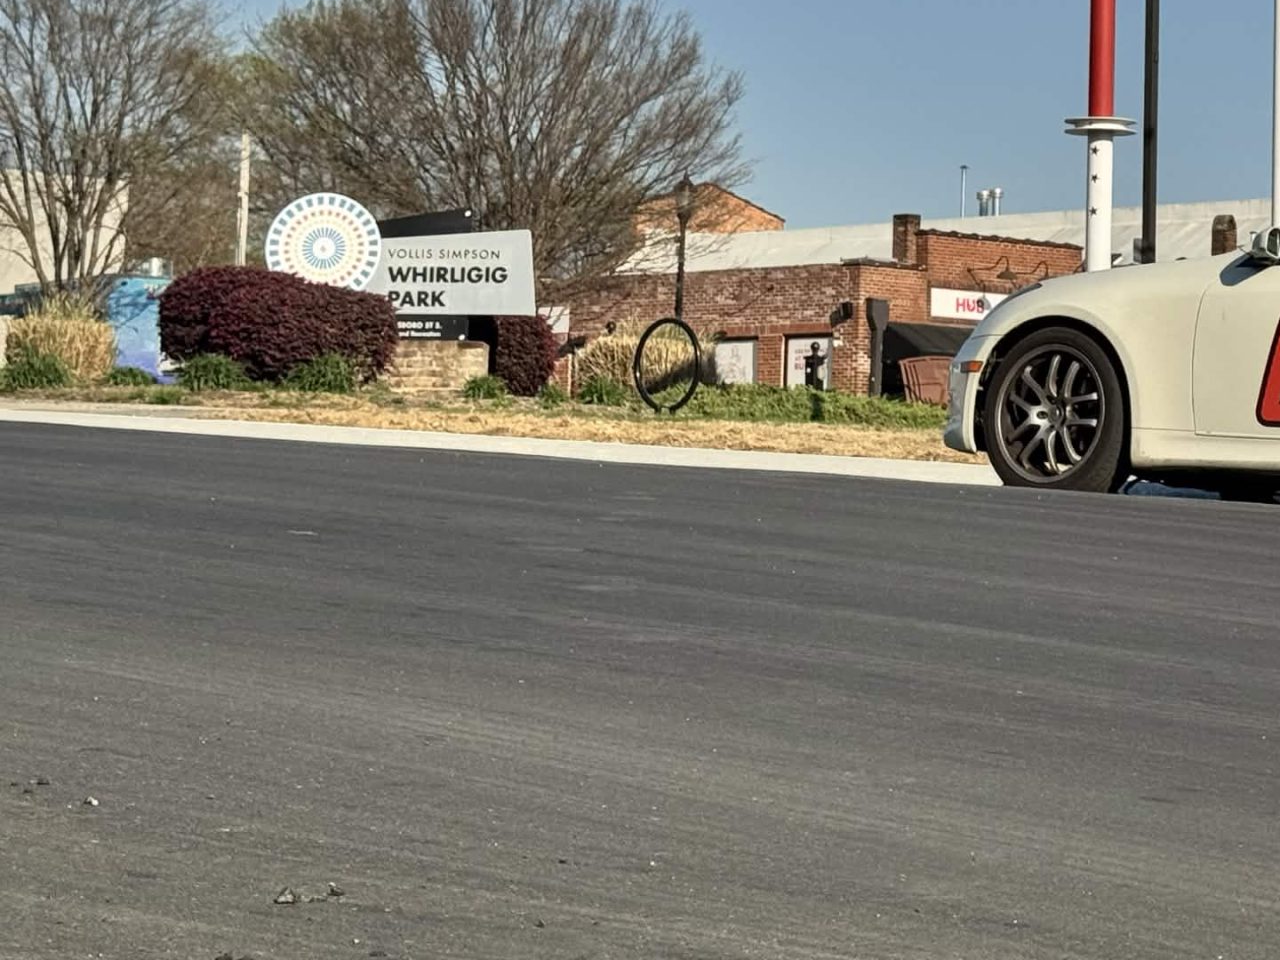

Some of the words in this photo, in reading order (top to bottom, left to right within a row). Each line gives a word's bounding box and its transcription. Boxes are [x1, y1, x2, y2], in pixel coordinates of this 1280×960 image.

[388, 248, 433, 260] VOLLIS
[439, 248, 501, 260] SIMPSON
[388, 266, 508, 283] WHIRLIGIG
[388, 290, 446, 307] PARK
